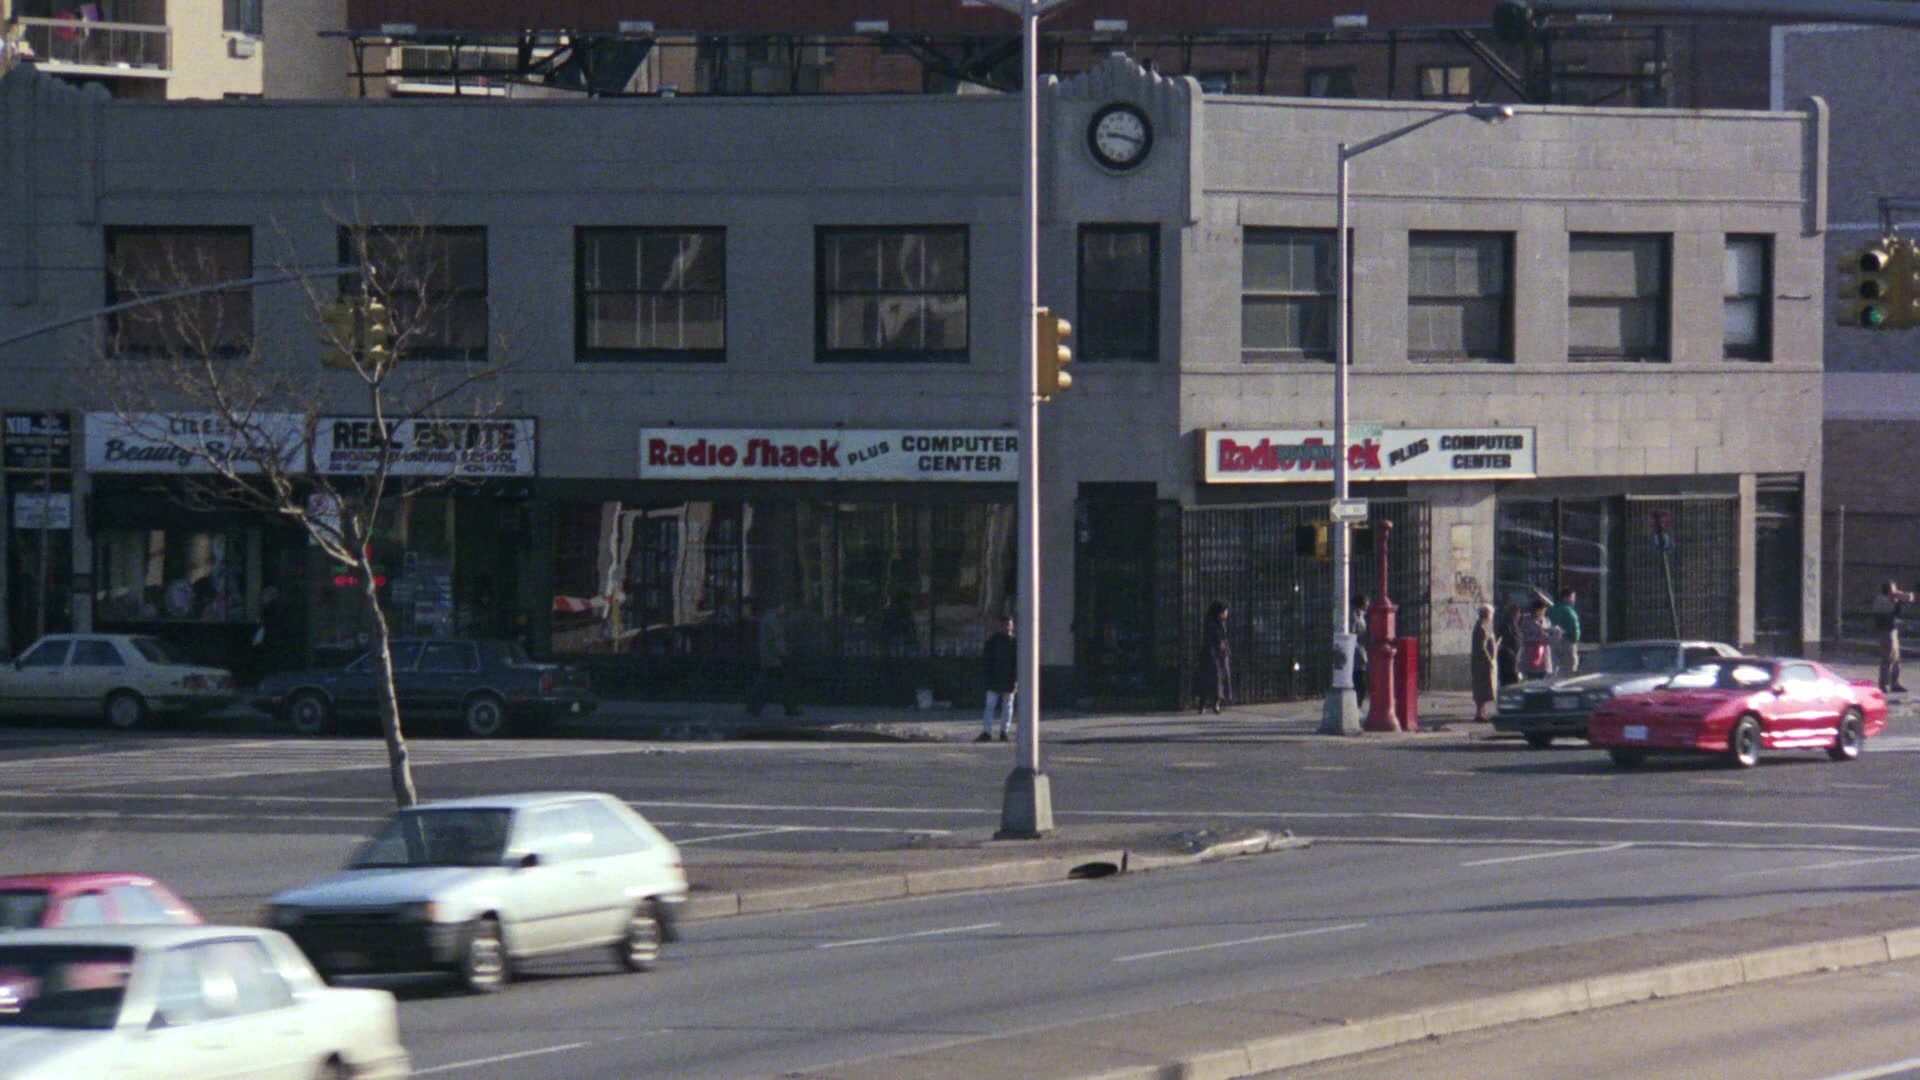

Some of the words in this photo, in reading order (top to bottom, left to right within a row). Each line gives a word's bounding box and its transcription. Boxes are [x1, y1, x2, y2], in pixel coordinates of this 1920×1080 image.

[333, 421, 404, 449] REAL
[413, 421, 516, 450] ESTATE
[901, 435, 1019, 453] COMPUTER
[1440, 435, 1524, 451] COMPUTER
[105, 438, 193, 466] Beauty
[648, 438, 738, 467] Radio
[743, 438, 840, 468] Shack
[847, 441, 891, 466] PLUS
[917, 455, 1002, 472] CENTER
[1388, 438, 1430, 467] PLUS
[1452, 454, 1512, 470] CENTER
